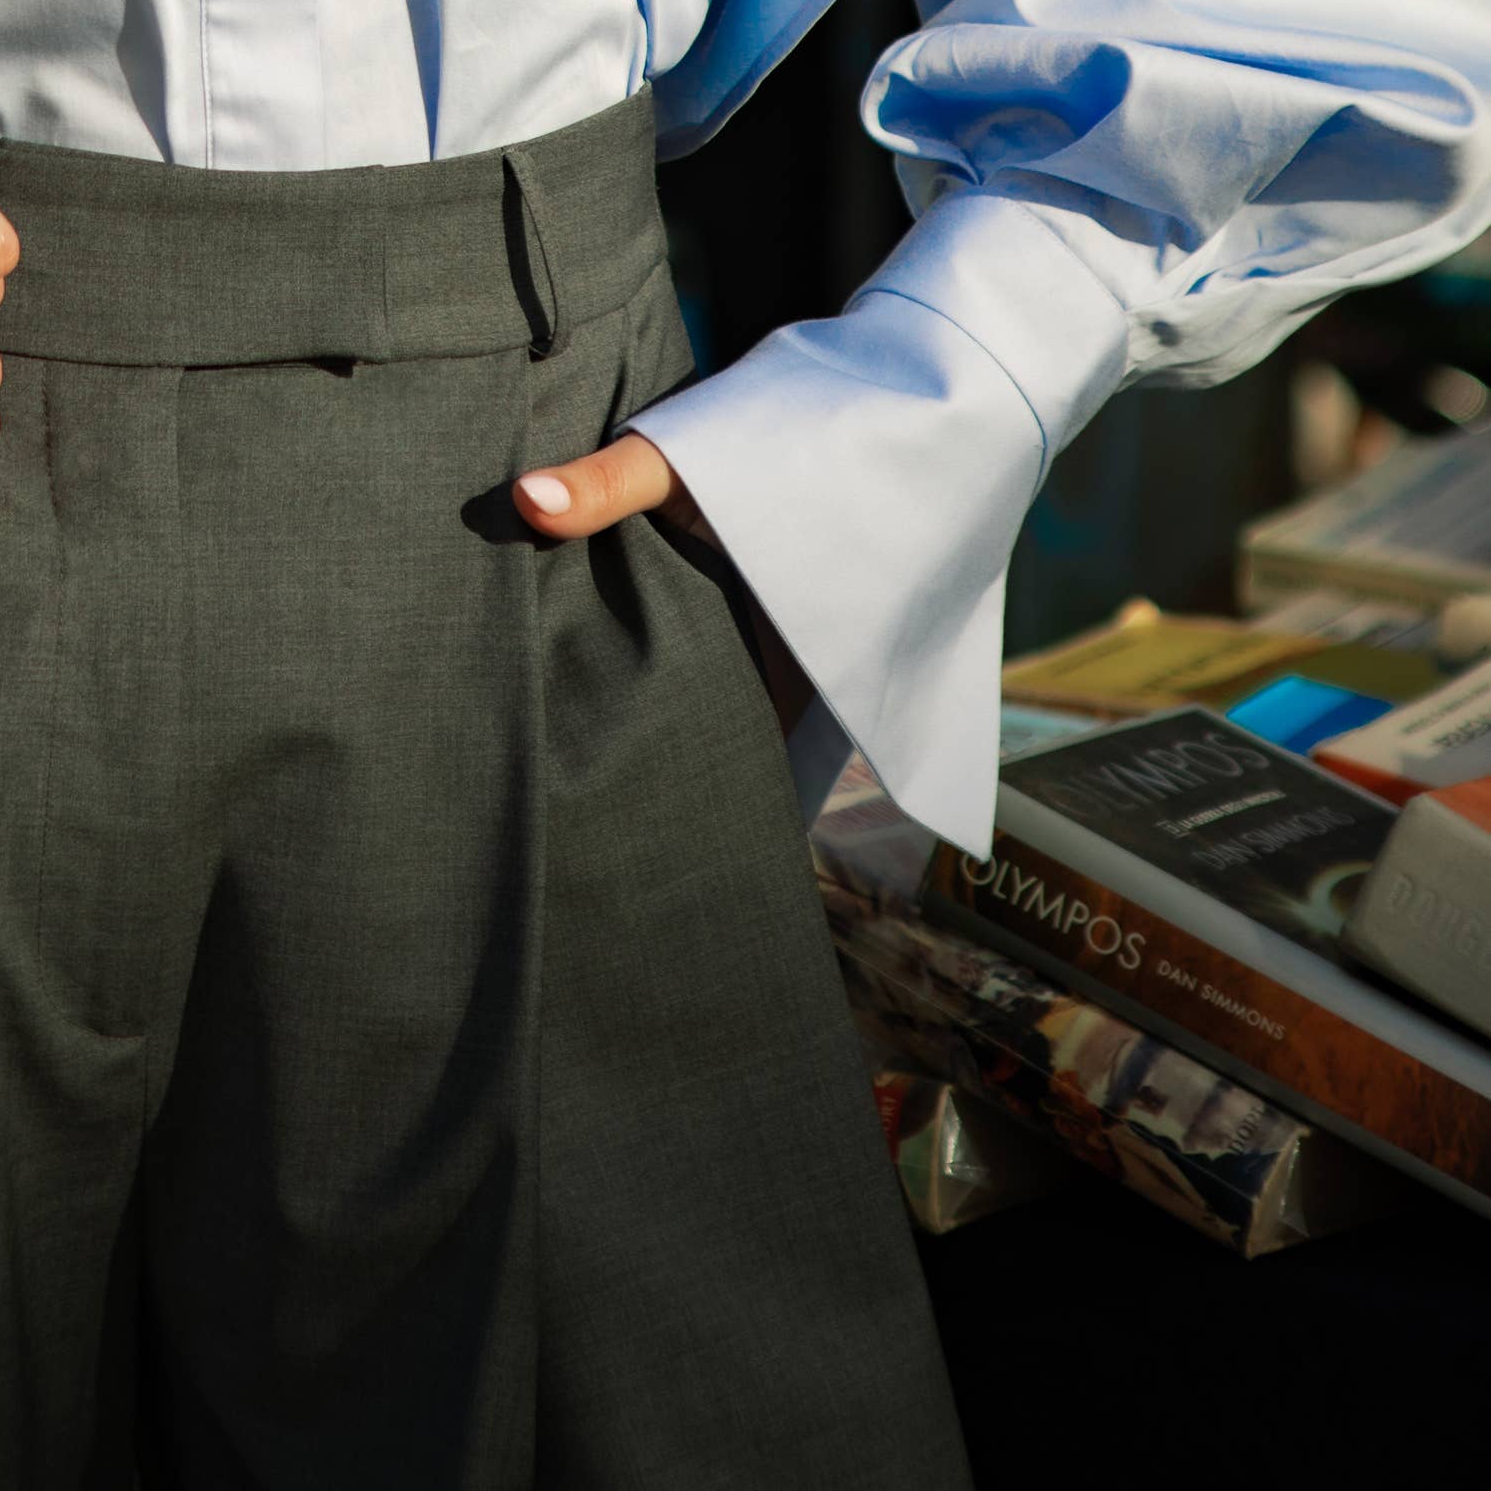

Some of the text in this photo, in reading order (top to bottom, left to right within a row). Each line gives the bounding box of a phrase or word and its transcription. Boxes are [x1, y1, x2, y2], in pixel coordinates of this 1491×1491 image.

[962, 852, 1287, 1042] OLYMPOS DAN SIMMONS
